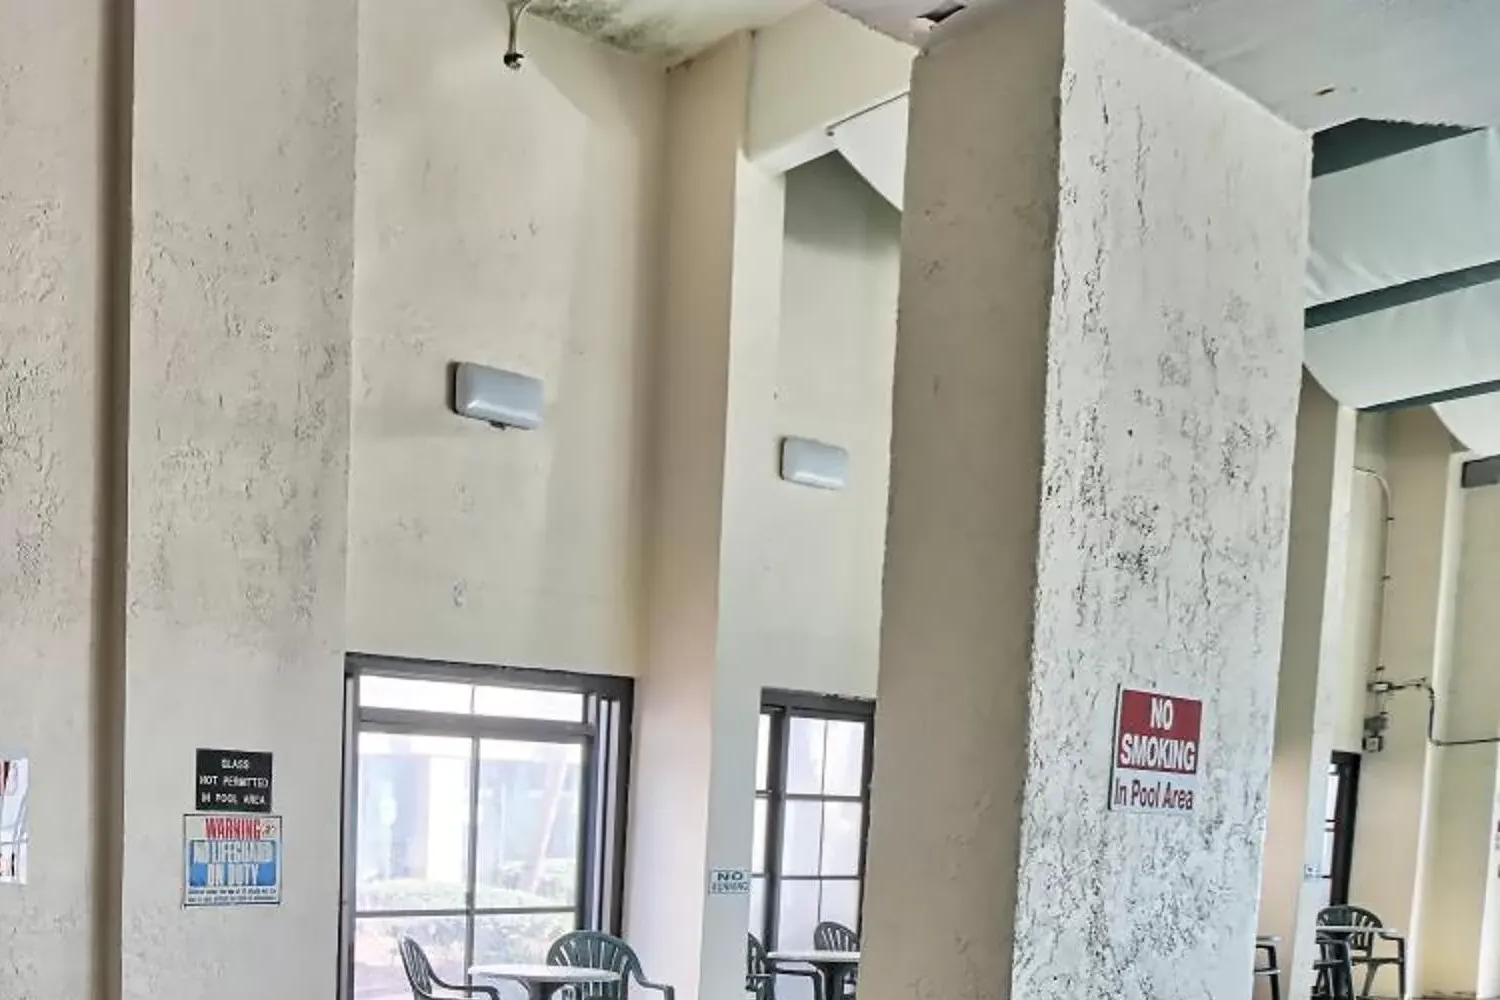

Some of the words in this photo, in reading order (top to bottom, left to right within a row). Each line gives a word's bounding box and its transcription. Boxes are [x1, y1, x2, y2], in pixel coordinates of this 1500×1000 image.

[1150, 697, 1174, 730] NO
[1120, 733, 1195, 771] SMOKING
[1114, 777, 1127, 806] In
[1131, 779, 1161, 808] Pool
[1162, 781, 1194, 810] Area
[204, 817, 261, 840] WARNING
[717, 871, 743, 881] NO
